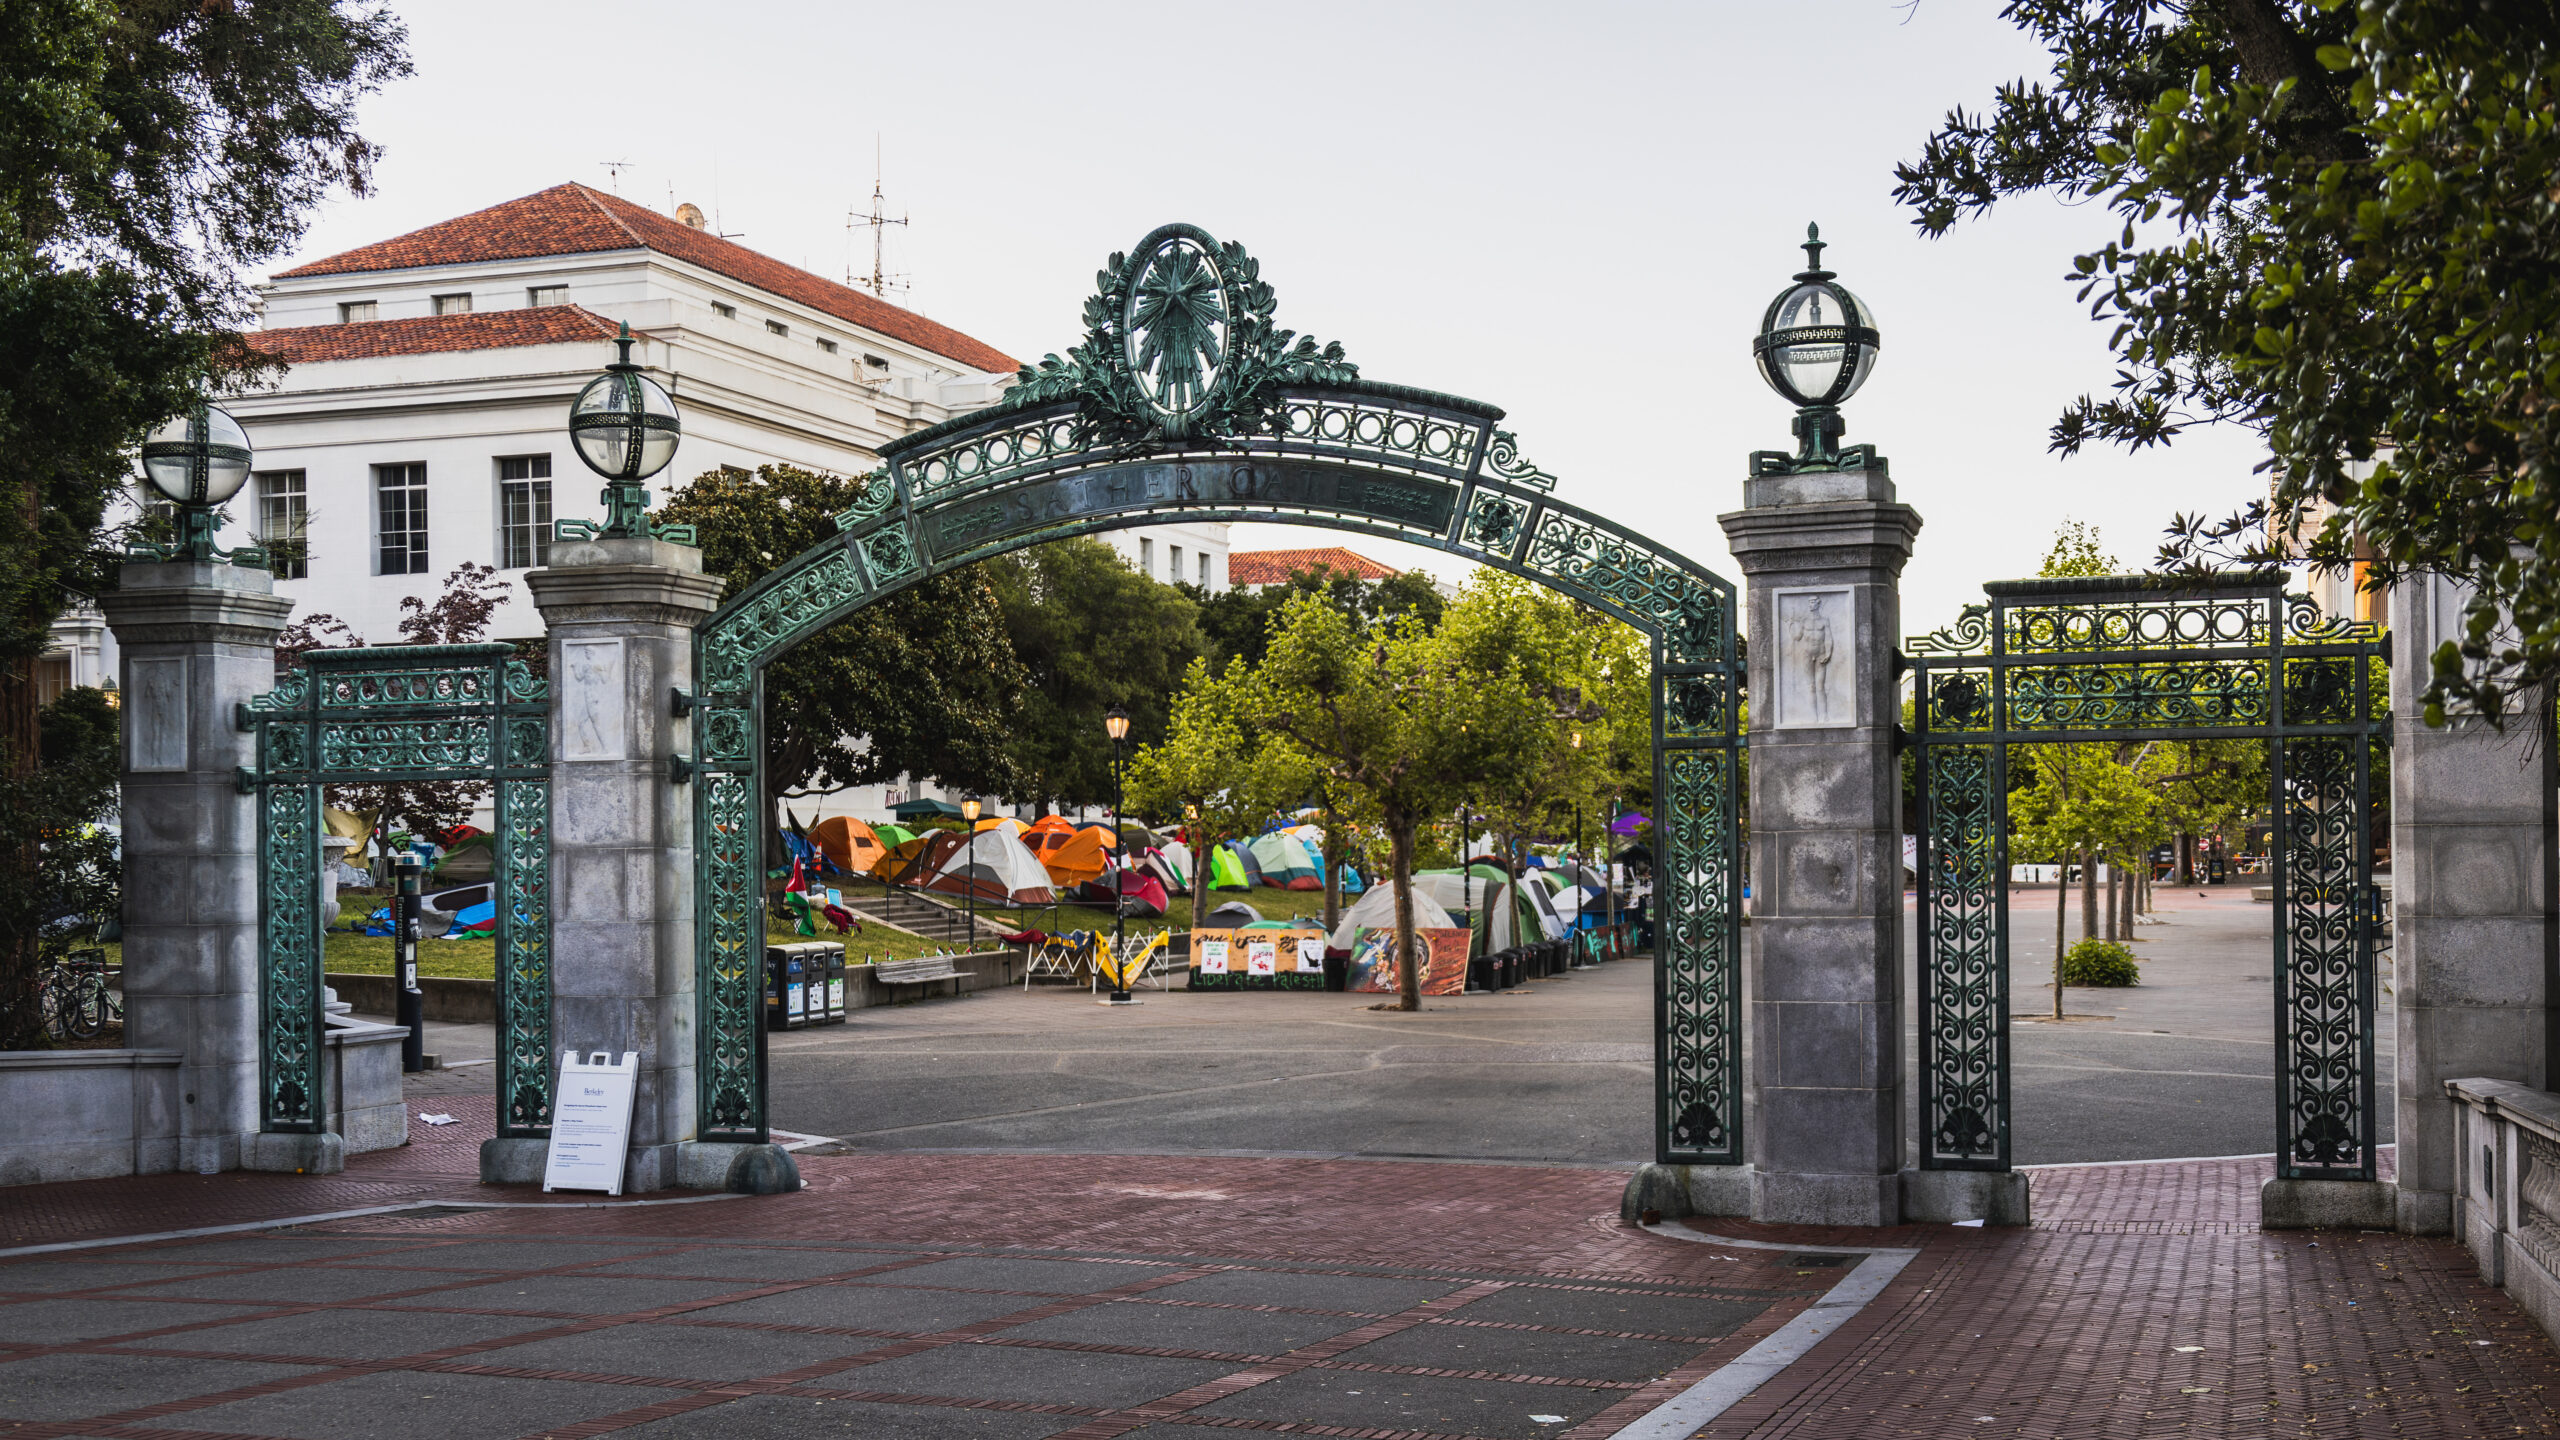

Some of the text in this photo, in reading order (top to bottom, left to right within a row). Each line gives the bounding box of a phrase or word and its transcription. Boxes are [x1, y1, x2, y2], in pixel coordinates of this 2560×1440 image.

[1016, 466, 1354, 521] SATHER GATE
[397, 896, 405, 953] Emergency
[1193, 968, 1265, 990] Liberate
